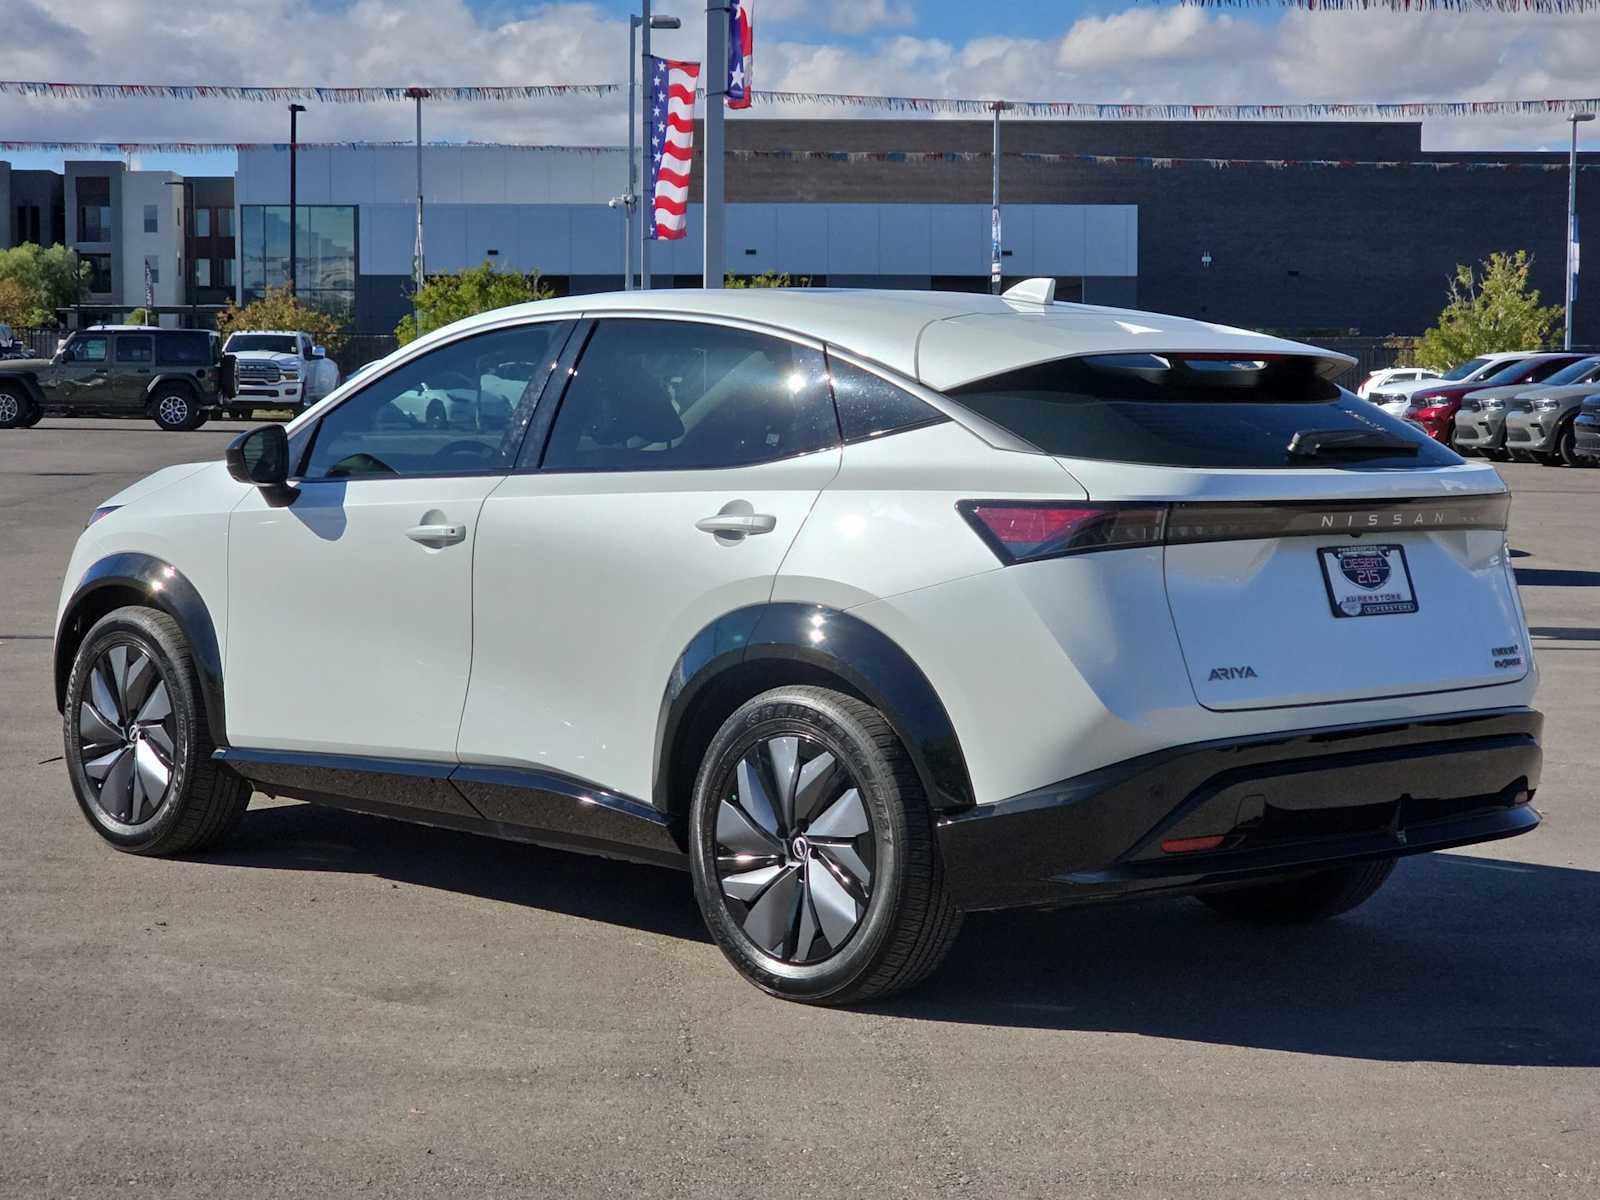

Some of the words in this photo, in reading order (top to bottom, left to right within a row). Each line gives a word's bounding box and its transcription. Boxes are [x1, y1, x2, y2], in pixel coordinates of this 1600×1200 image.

[1321, 512, 1444, 527] NISSAN
[1344, 557, 1384, 569] DESERT
[1356, 569, 1381, 584] 215
[1346, 593, 1402, 603] SUPERSTORE
[1207, 665, 1259, 682] ARIYA
